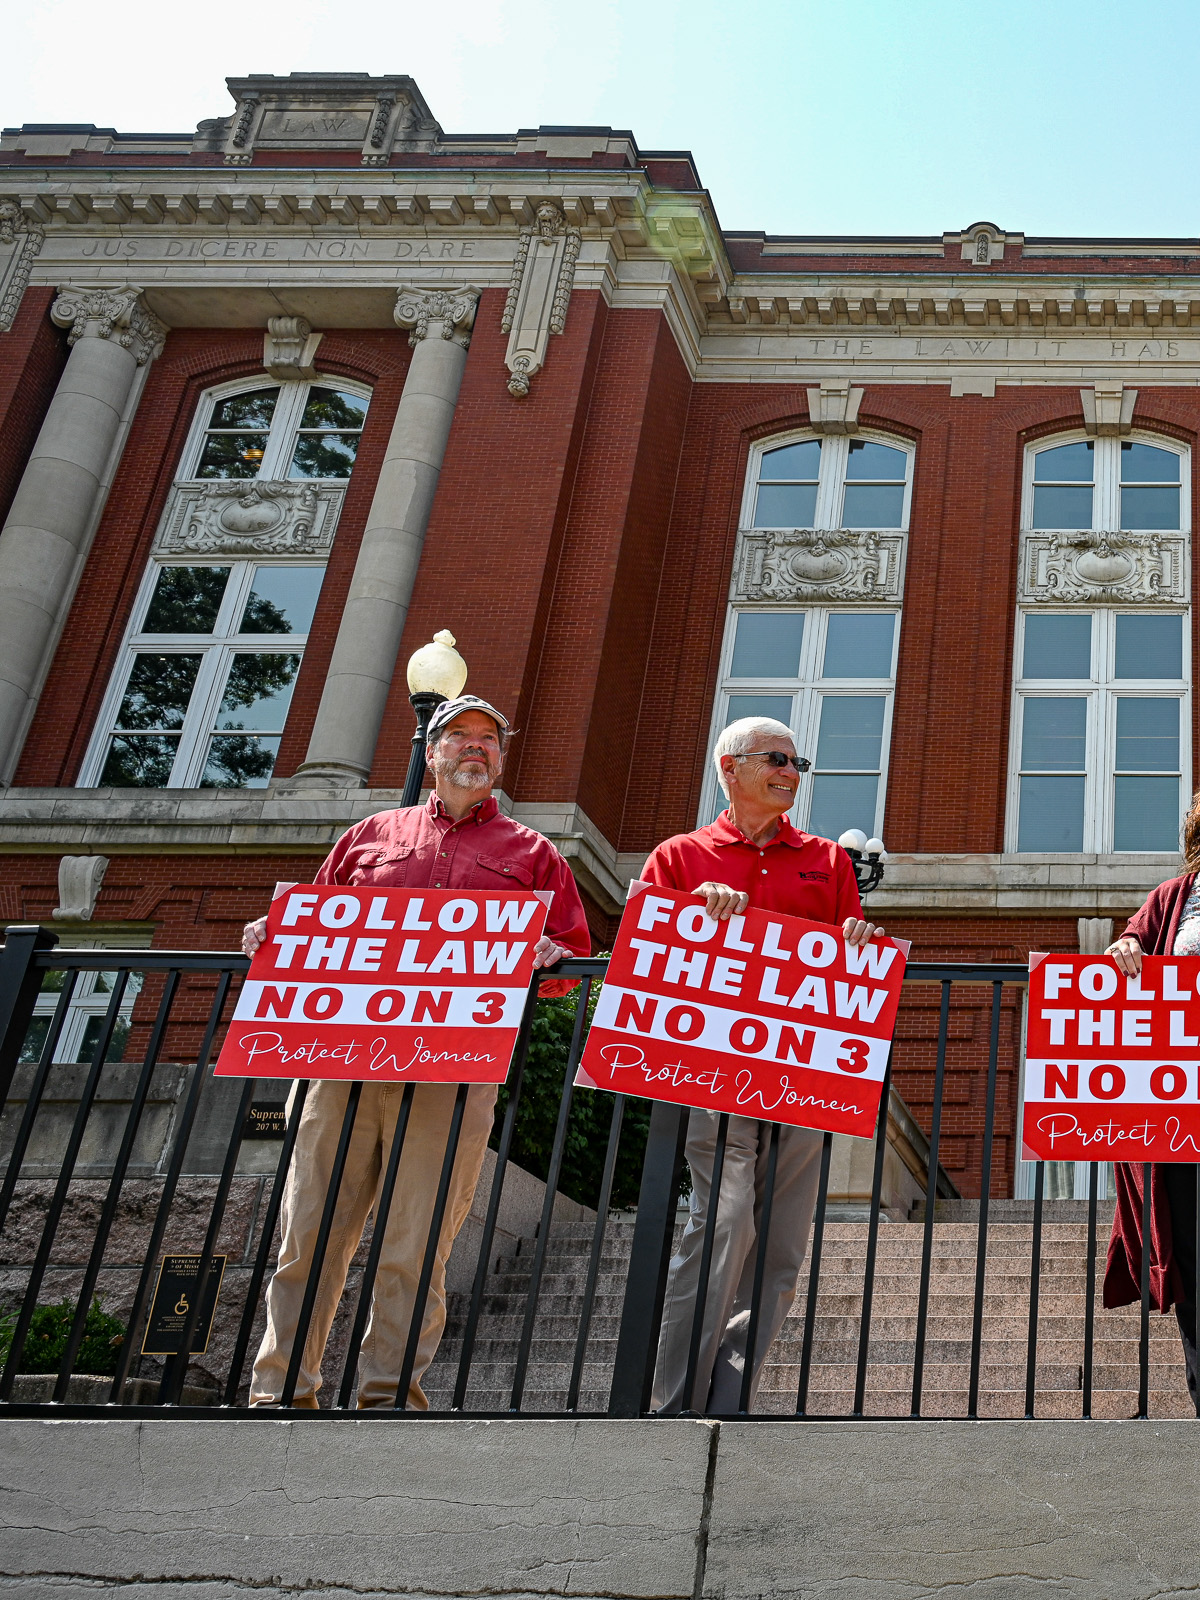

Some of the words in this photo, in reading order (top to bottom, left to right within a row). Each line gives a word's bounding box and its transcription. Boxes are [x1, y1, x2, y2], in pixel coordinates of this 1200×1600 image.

[282, 118, 347, 133] LAW
[82, 240, 140, 257] JUS
[164, 241, 279, 258] DICERE
[301, 241, 371, 258] NON
[394, 242, 476, 258] DARE
[809, 339, 873, 356] THE
[914, 340, 992, 357] LAW
[1034, 341, 1067, 357] IT
[1110, 341, 1179, 358] HAS
[281, 894, 539, 933] FOLLOW
[272, 934, 387, 971] THE
[396, 939, 529, 975] LAW
[636, 895, 899, 980] FOLLOW
[629, 938, 747, 997] THE
[758, 967, 889, 1024] LAW
[254, 986, 344, 1020] NO
[365, 989, 453, 1023] ON
[471, 992, 507, 1025] 3
[613, 992, 706, 1041] NO
[728, 1017, 817, 1065] ON
[836, 1039, 871, 1074] 3
[1040, 1009, 1152, 1046] THE
[239, 1031, 363, 1066] Protect
[370, 1036, 496, 1072] Women
[600, 1044, 728, 1093] Protect
[735, 1069, 864, 1115] Women
[1044, 1064, 1126, 1100] NO
[255, 1123, 269, 1131] 207
[1037, 1112, 1158, 1150] Protect
